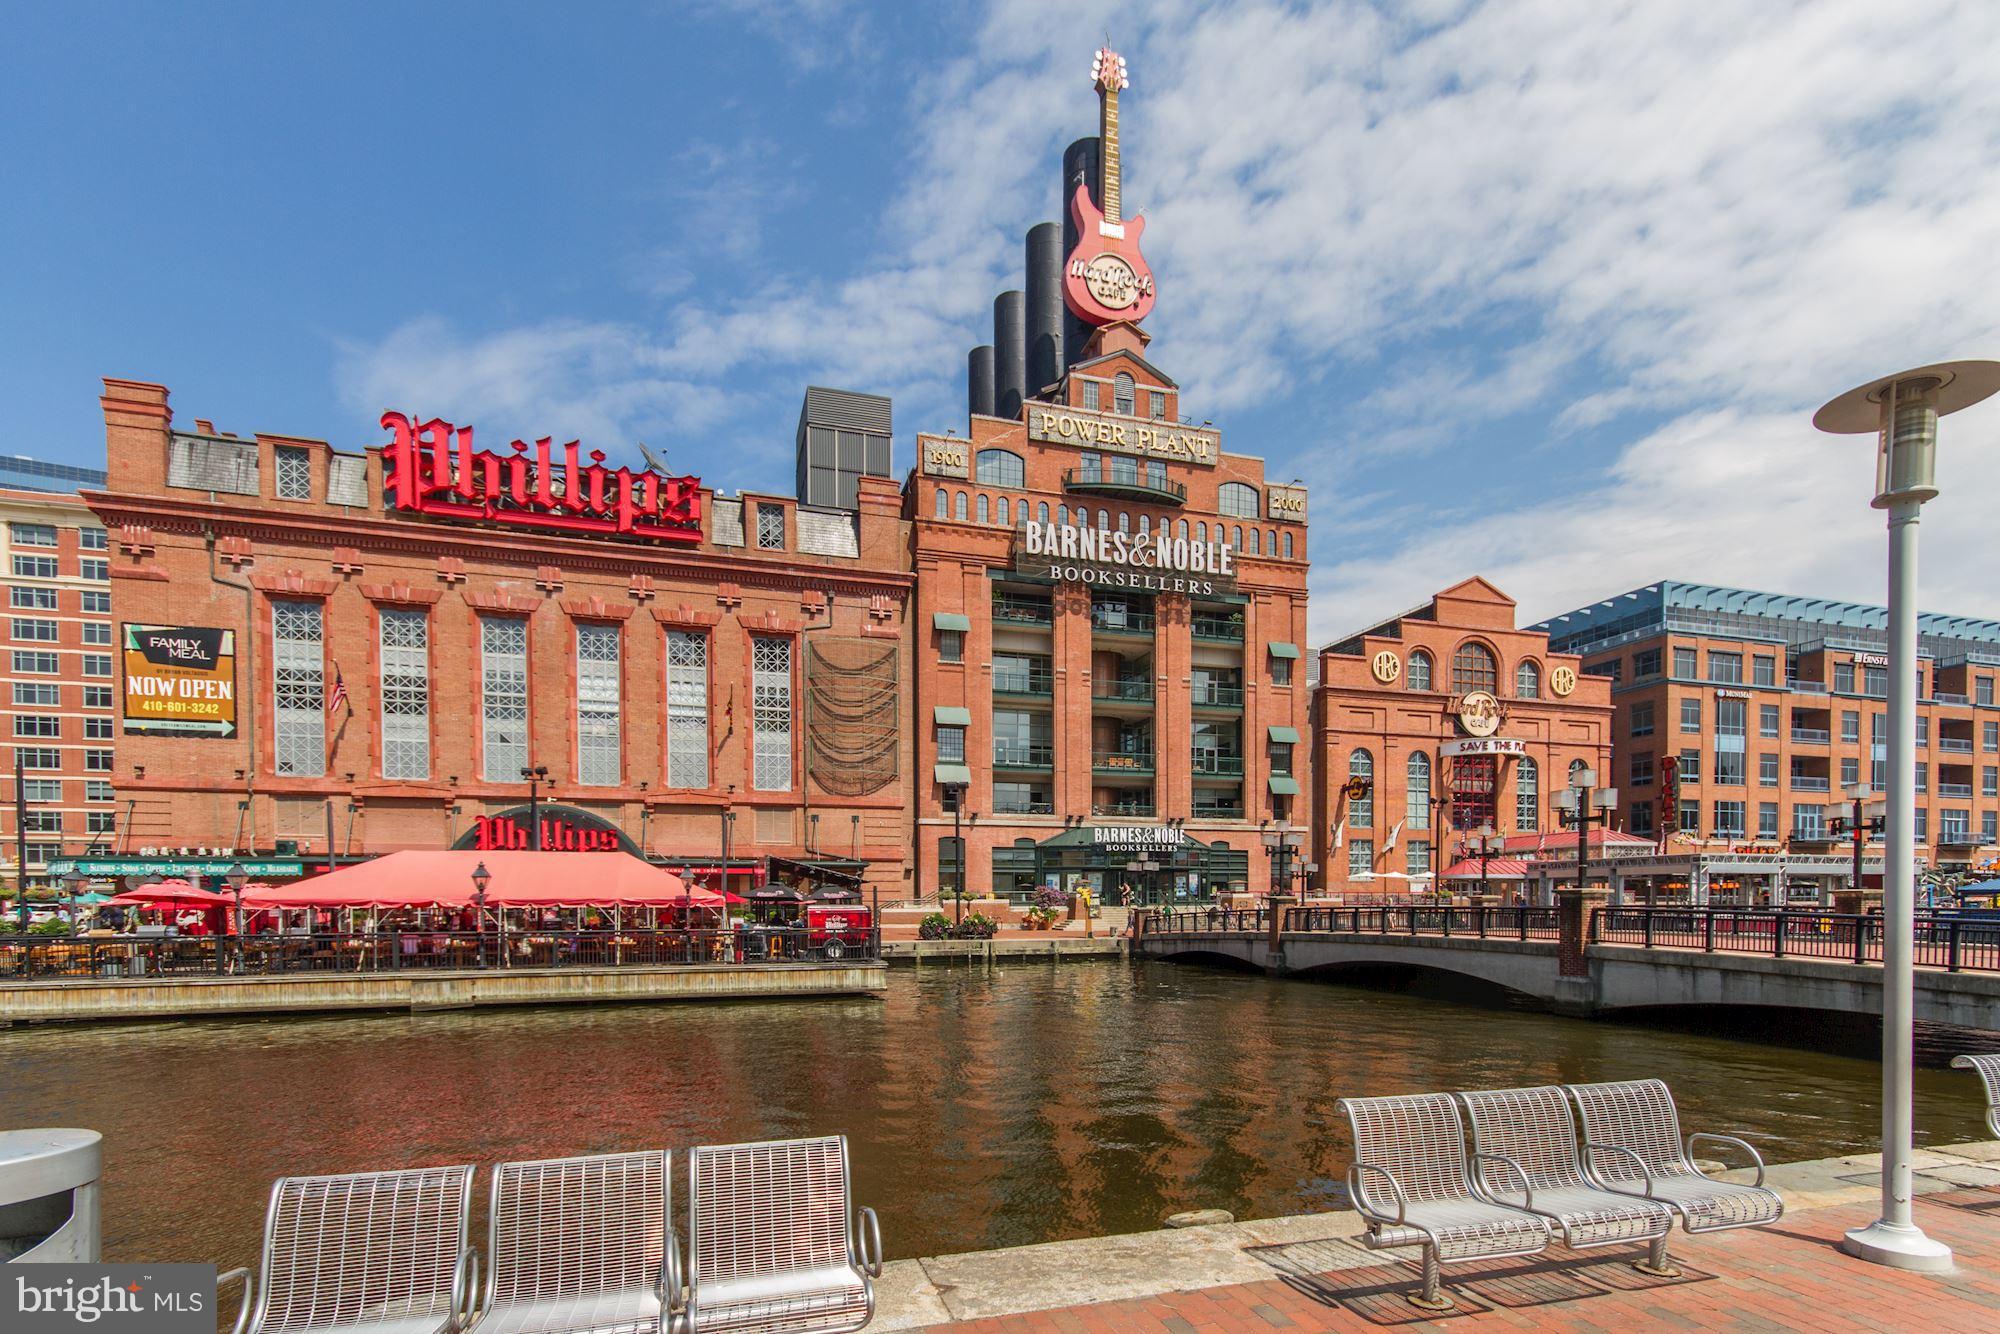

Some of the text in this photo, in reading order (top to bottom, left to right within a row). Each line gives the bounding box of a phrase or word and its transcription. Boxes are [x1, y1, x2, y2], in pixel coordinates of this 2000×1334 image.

[1071, 259, 1153, 297] Hard Rock
[1040, 413, 1210, 458] POWER PLANT
[930, 450, 963, 467] 1900
[381, 411, 702, 539] Phillips
[1273, 496, 1303, 512] 2000
[1050, 565, 1212, 595] BOOKSELLERS
[150, 637, 201, 650] FAMILY
[169, 648, 211, 660] MEAL
[128, 676, 233, 700] NOW OPEN
[142, 700, 220, 714] 410-601-3242
[1447, 697, 1480, 715] Hard
[1460, 741, 1488, 752] SAVE
[1494, 741, 1512, 752] THE
[475, 815, 619, 852] Phllips
[1106, 844, 1178, 852] BOOKSELLERS
